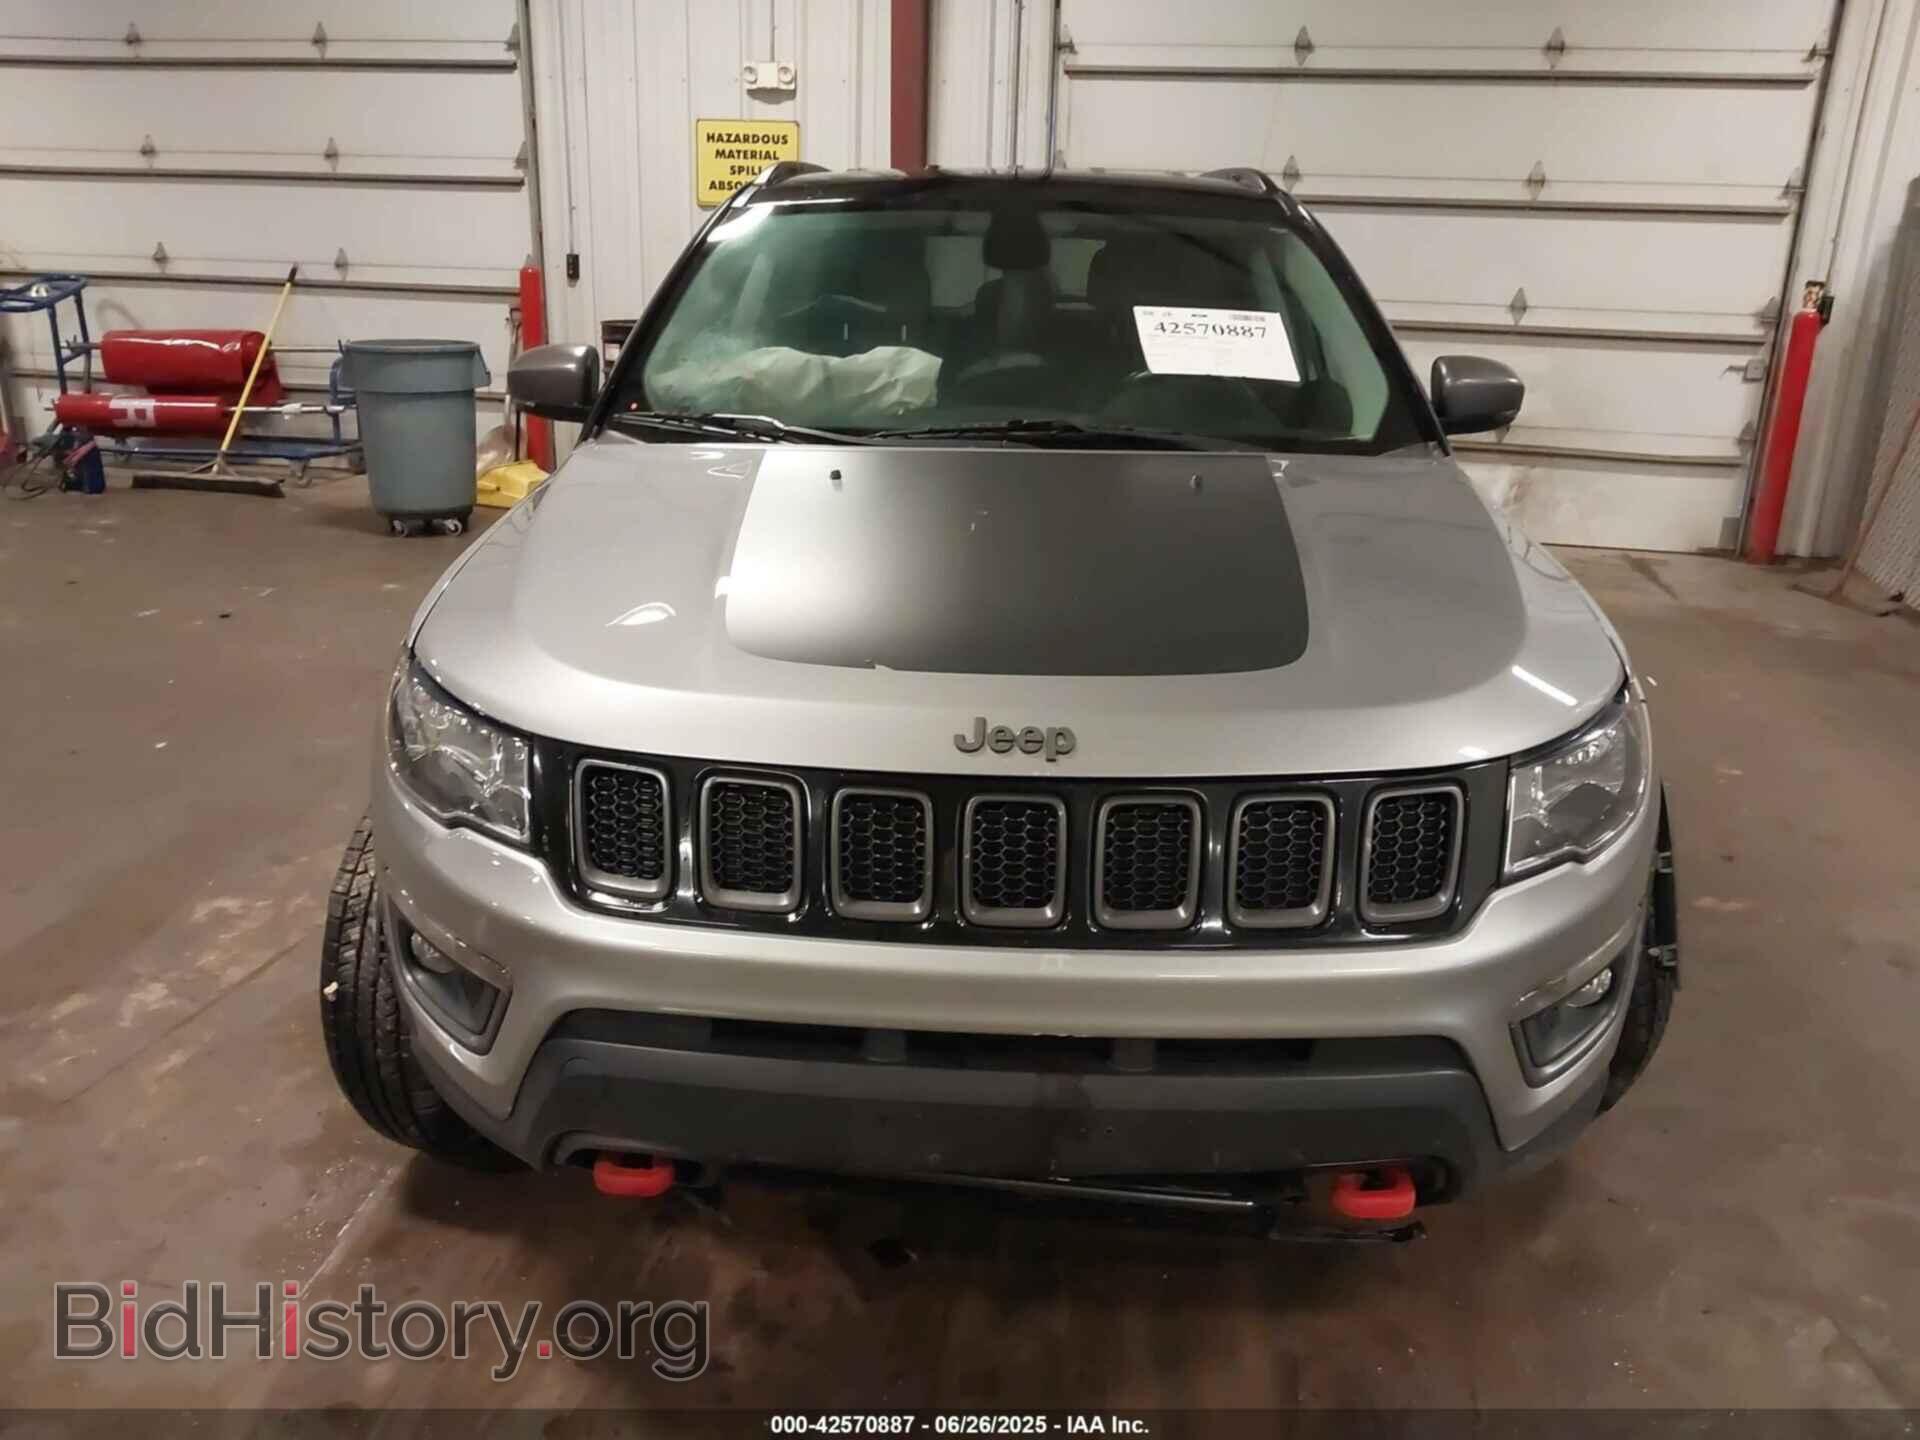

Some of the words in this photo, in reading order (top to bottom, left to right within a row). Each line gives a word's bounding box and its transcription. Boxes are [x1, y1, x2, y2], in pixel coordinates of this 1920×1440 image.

[706, 132, 788, 145] HAZARDOUS
[714, 149, 780, 161] MATERIAL
[1154, 321, 1267, 339] 42570887
[953, 716, 1077, 763] Jeep
